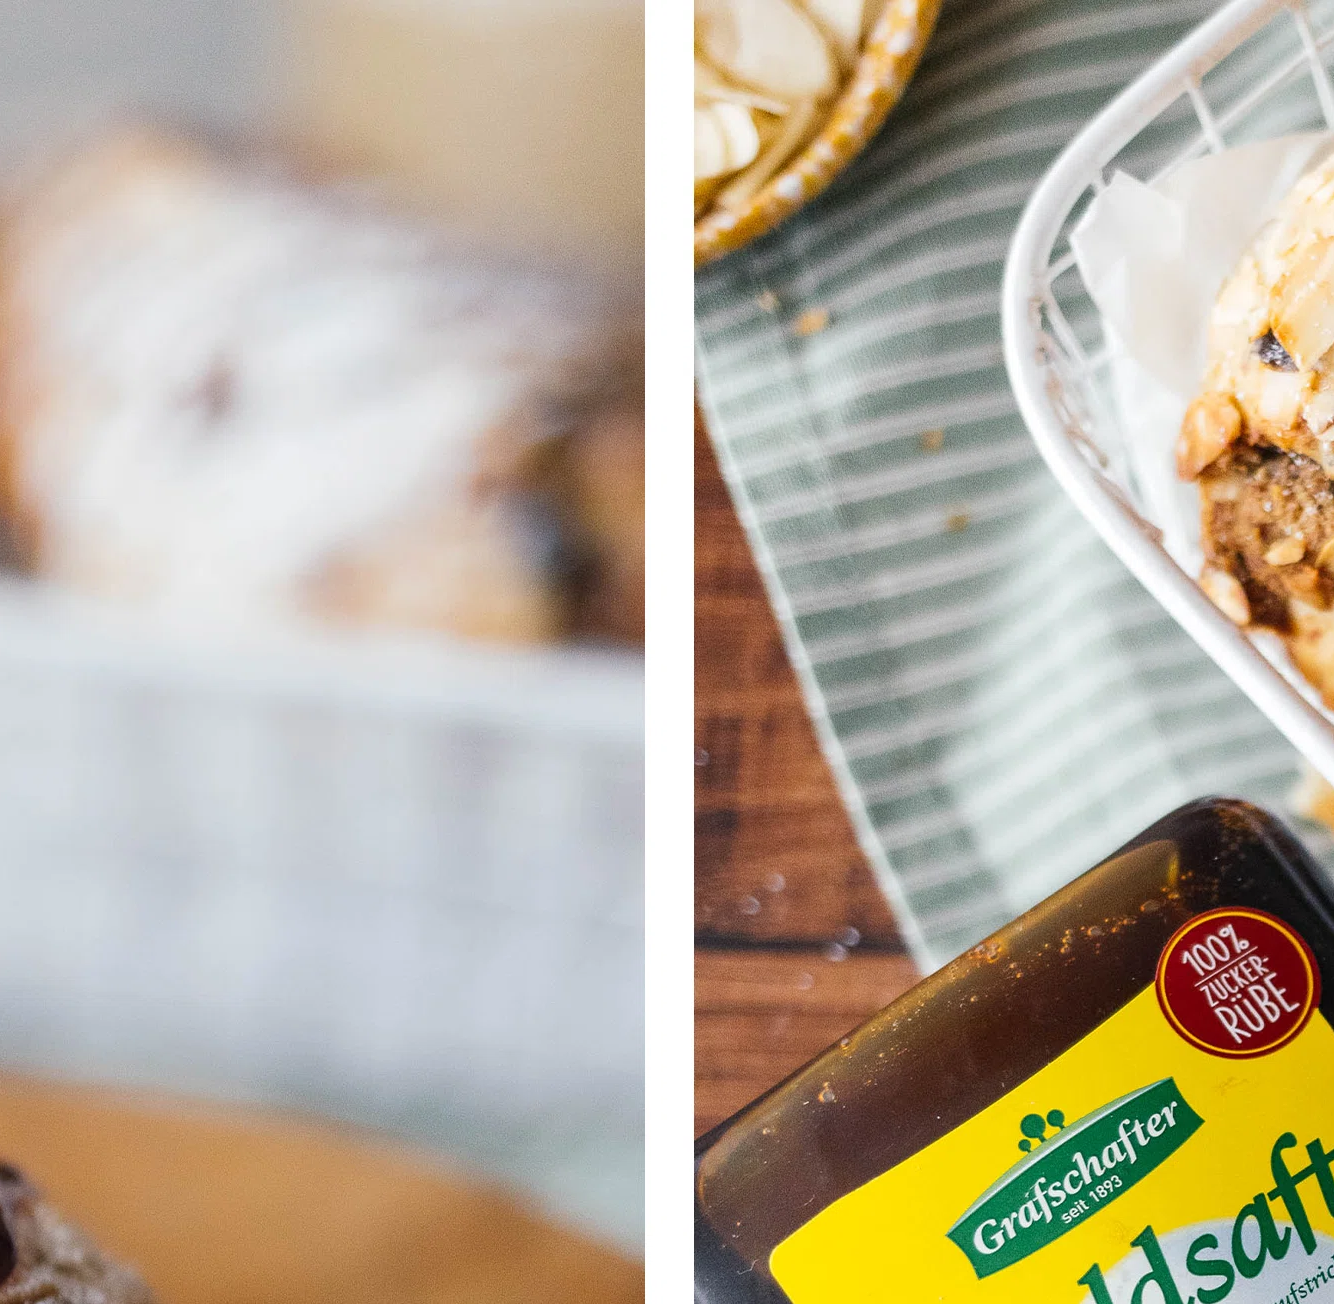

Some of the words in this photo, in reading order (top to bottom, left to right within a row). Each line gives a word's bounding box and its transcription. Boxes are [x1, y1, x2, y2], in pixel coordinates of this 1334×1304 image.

[1181, 923, 1251, 977] 100%
[1199, 955, 1270, 1008] ZUCKER-
[1214, 971, 1301, 1045] RÜBE
[972, 1100, 1179, 1256] Grafschafter
[1061, 1199, 1090, 1224] seit
[1089, 1174, 1124, 1203] 1893
